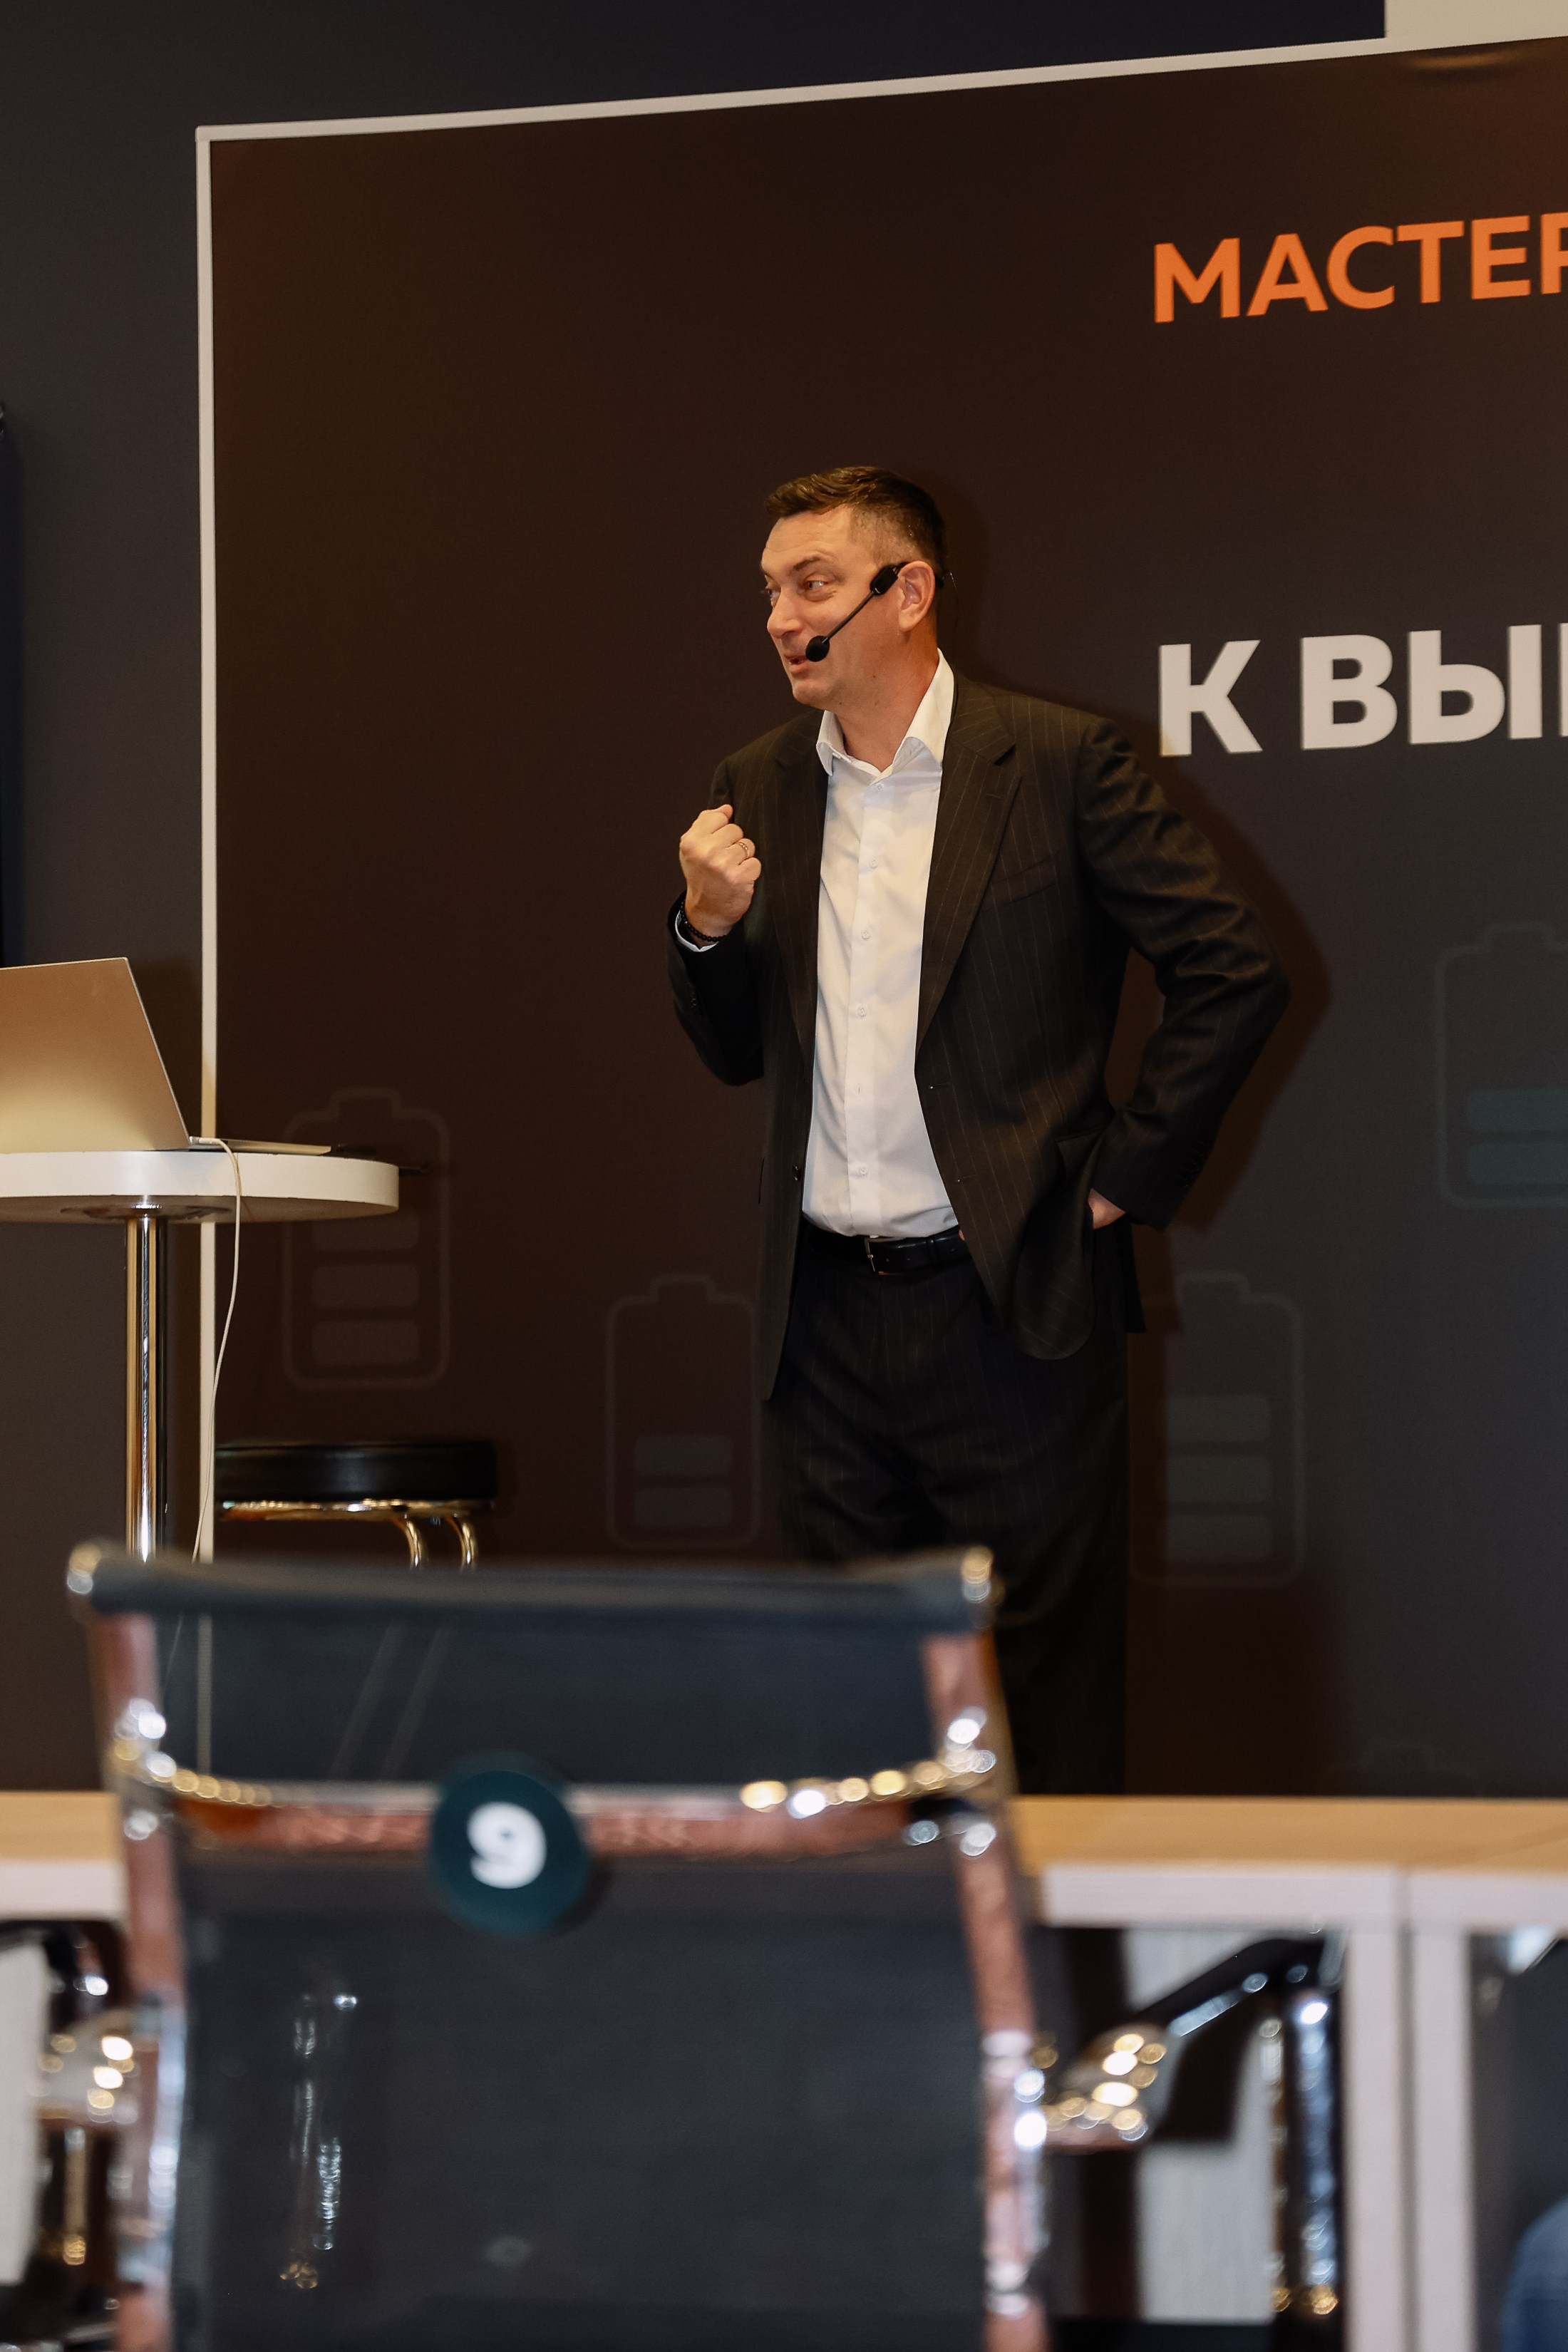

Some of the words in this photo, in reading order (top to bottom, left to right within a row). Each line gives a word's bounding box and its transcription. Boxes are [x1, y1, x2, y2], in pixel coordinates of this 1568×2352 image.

[1160, 639, 1263, 757] К
[1301, 622, 1568, 750] ВЫ
[467, 1801, 547, 1889] 9
